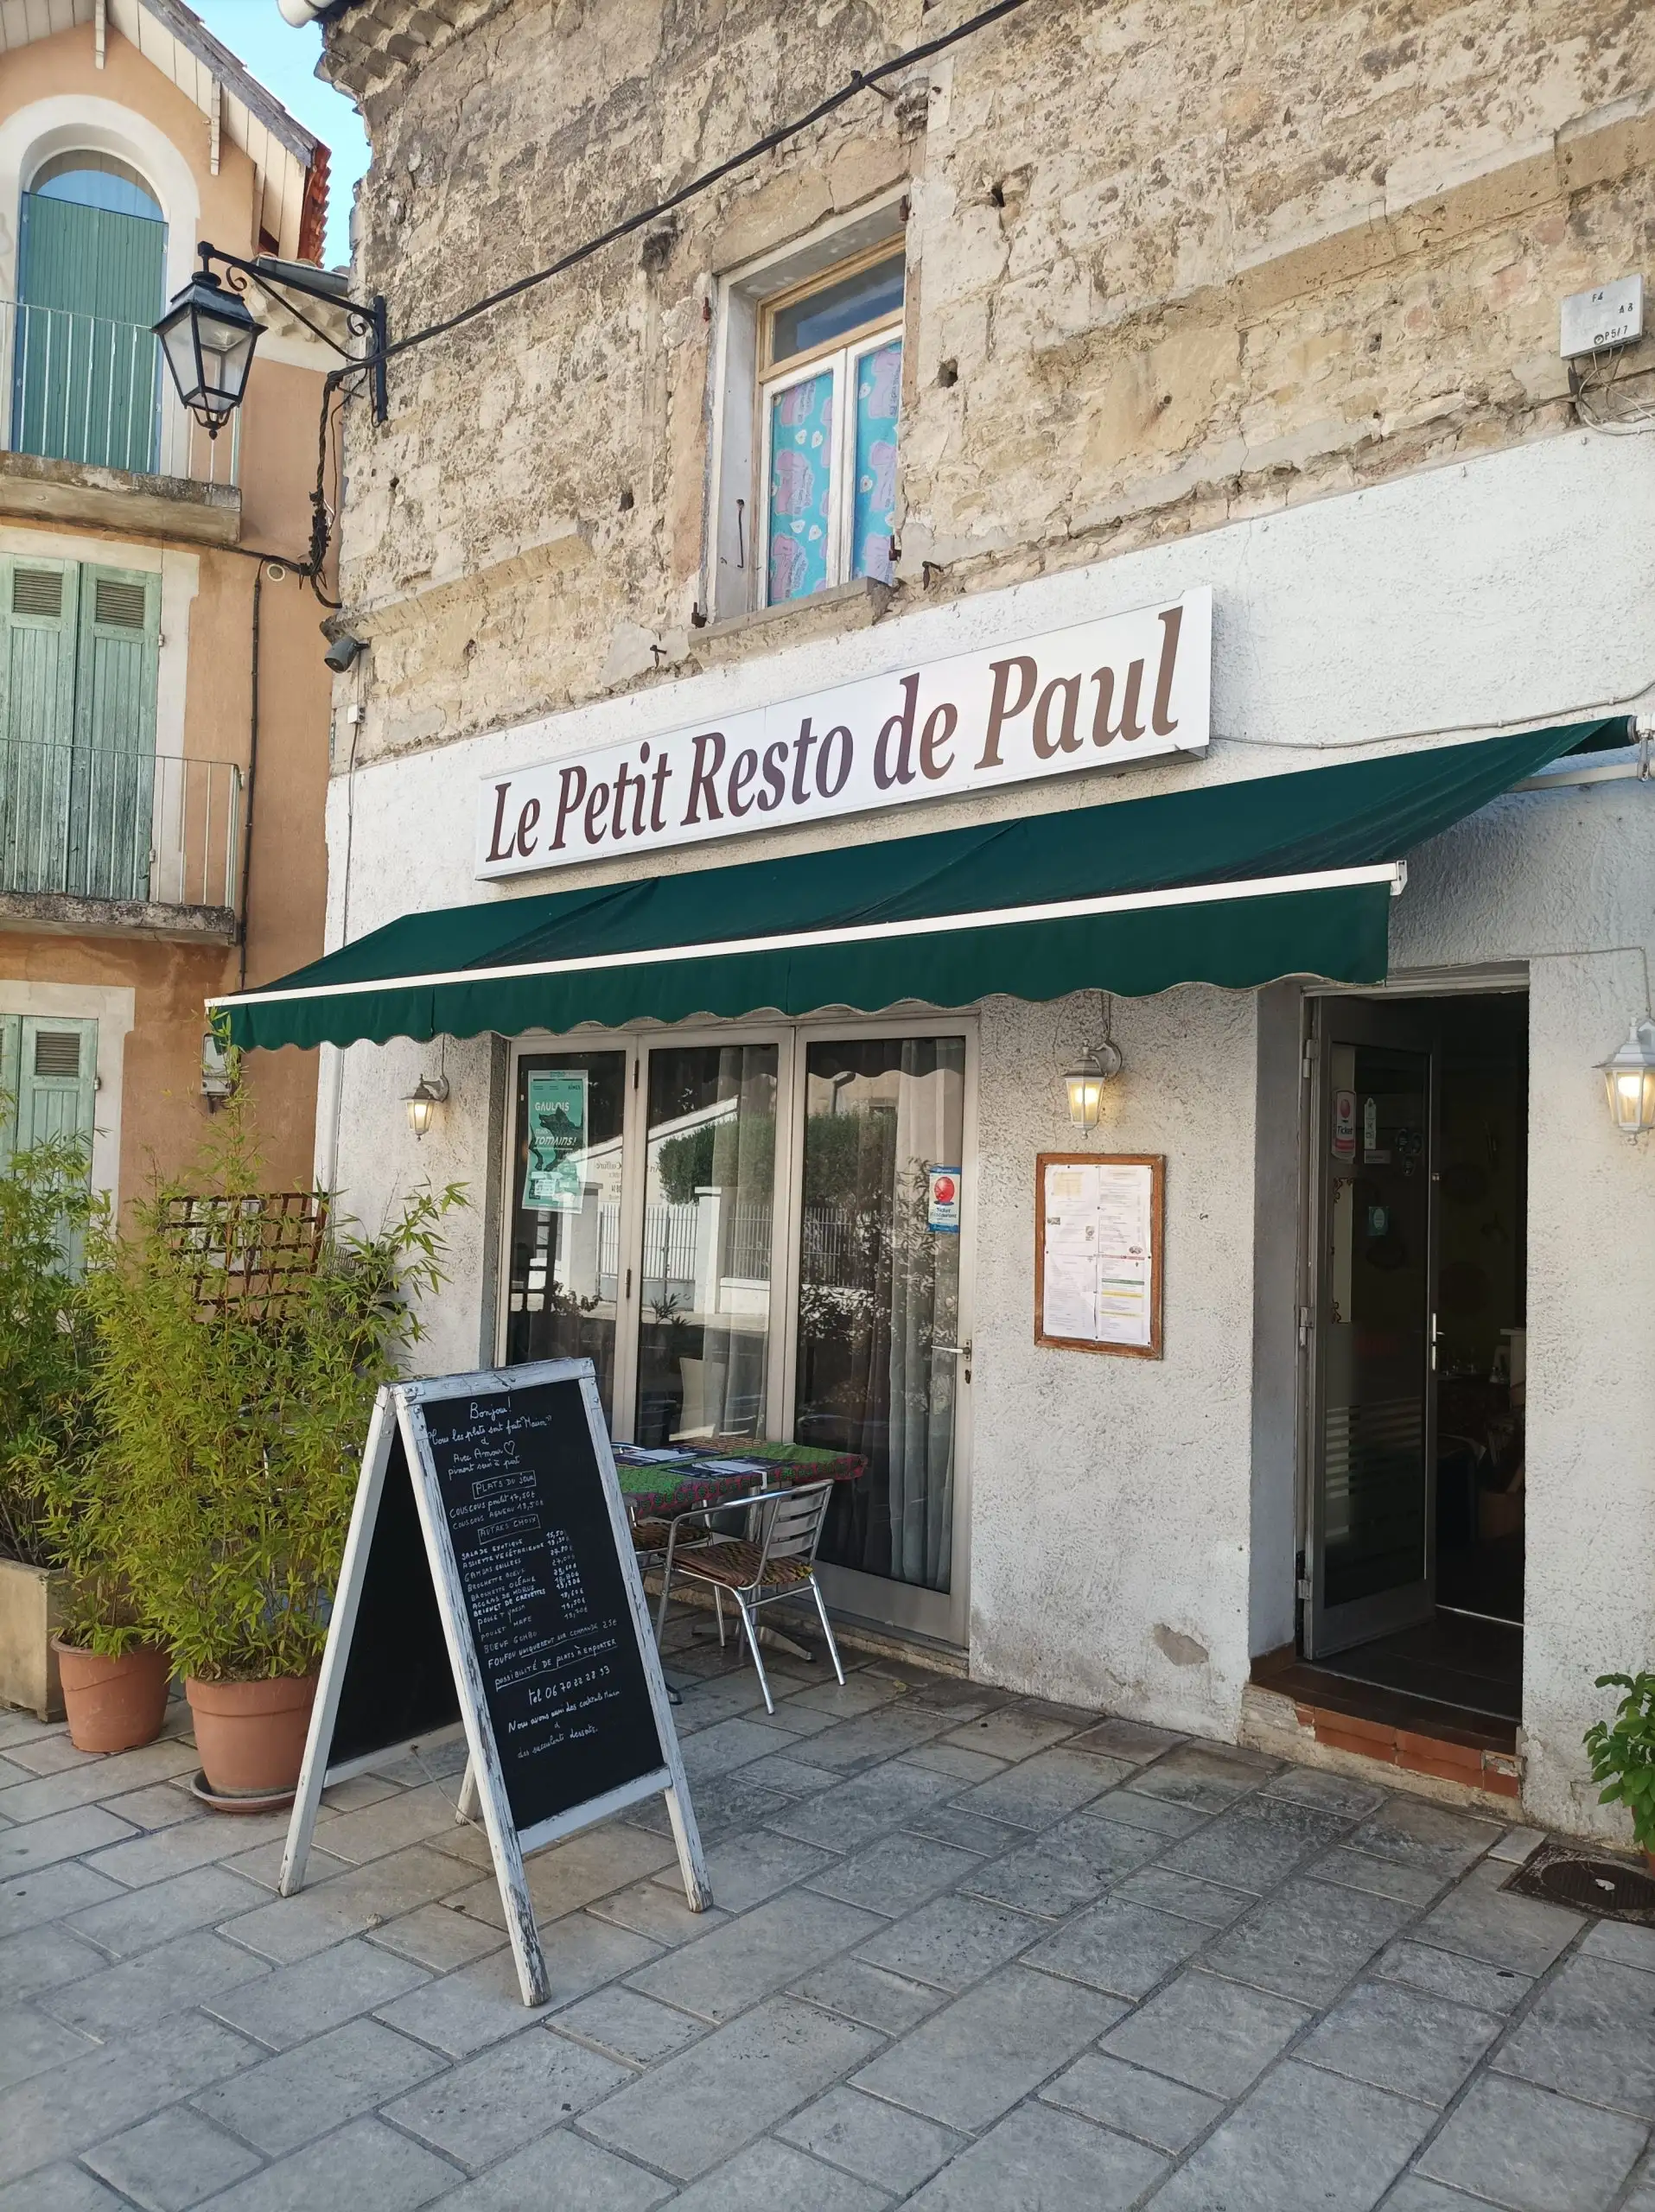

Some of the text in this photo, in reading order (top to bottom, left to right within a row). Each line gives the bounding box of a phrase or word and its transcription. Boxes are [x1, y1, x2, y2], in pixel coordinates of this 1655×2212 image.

[485, 605, 1185, 863] Le Petit Resto de Paul
[475, 1480, 503, 1495] PLATS
[480, 1517, 537, 1537] AUTRES CHOIX
[461, 1548, 488, 1560] SALADE
[542, 1658, 552, 1669] DE
[545, 1684, 557, 1699] 06
[559, 1681, 571, 1692] 70
[566, 1701, 577, 1713] des
